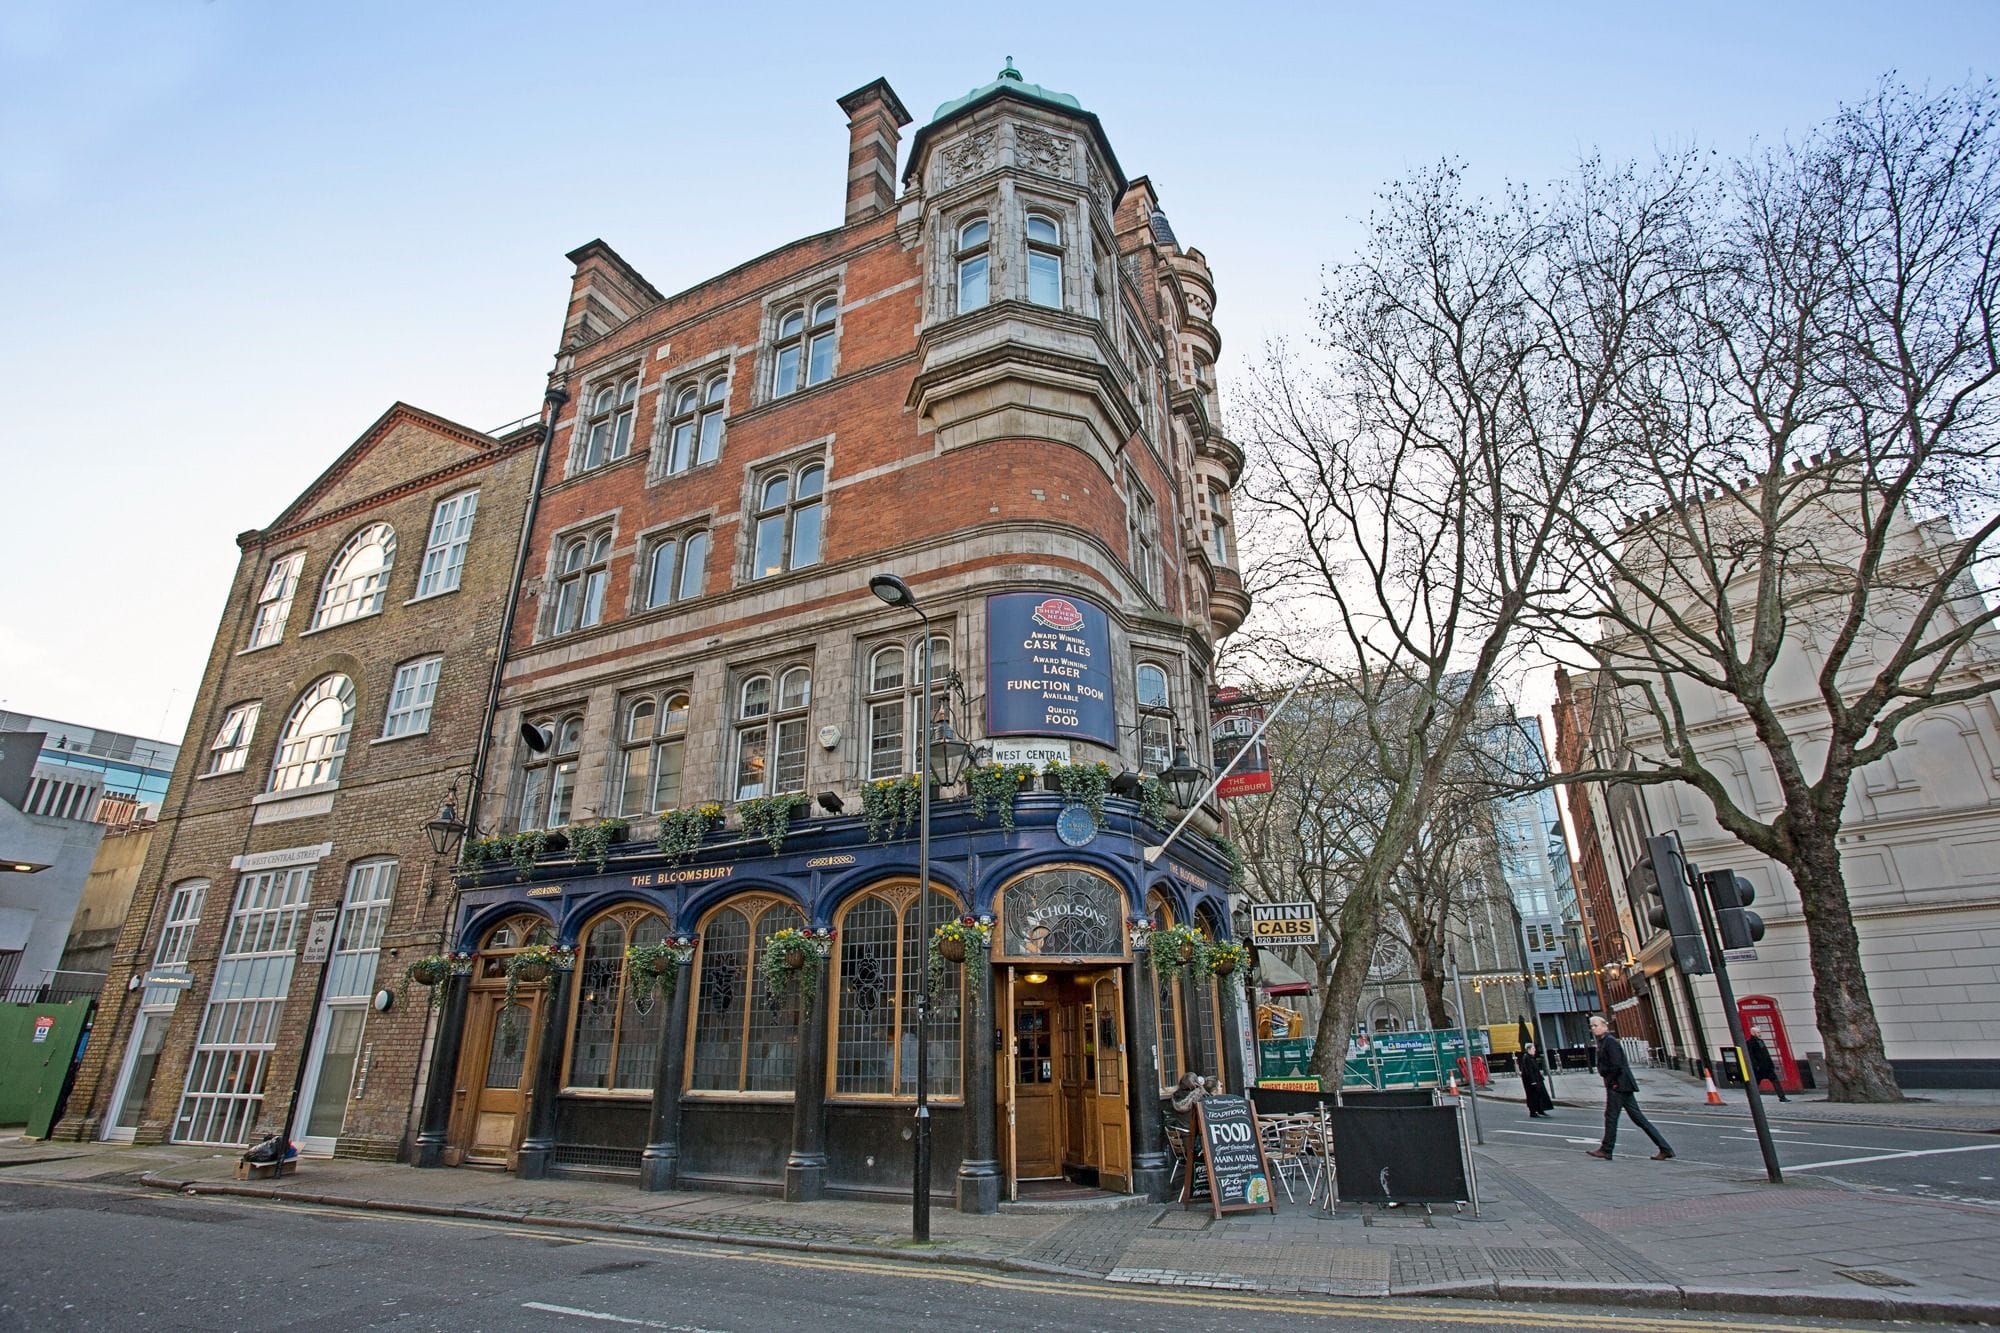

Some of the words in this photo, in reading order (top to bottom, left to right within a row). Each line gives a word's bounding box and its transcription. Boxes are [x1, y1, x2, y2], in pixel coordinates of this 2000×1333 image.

[1038, 608, 1080, 619] SHEPHERD
[1048, 614, 1073, 622] NEAME
[1032, 632, 1058, 640] AWARD
[1058, 633, 1086, 646] WINNING
[1024, 640, 1058, 650] CASK
[1065, 643, 1090, 656] ALES
[1032, 656, 1060, 664] AWARD
[1060, 658, 1088, 670] WINNING
[1043, 664, 1080, 678] LAGER
[1007, 680, 1070, 692] FUNCTION
[1077, 684, 1104, 700] ROOM
[1042, 692, 1079, 702] AVAILABLE
[1048, 706, 1076, 715] QUALITY
[1045, 714, 1079, 726] FOOD
[996, 750, 1021, 760] WEST
[1026, 750, 1068, 760] CENTRAL
[1220, 782, 1267, 794] OOMSBURY
[1228, 777, 1246, 786] THE
[268, 852, 296, 864] CENTRAL
[296, 849, 320, 860] STREET
[631, 875, 652, 886] THE
[657, 866, 734, 884] BLOOMSBURY
[1256, 906, 1310, 920] MINI
[1258, 920, 1312, 934] CABS
[1257, 936, 1272, 944] 020
[1208, 1122, 1251, 1145] FOOD
[1214, 1155, 1234, 1164] MAIN
[1234, 1154, 1258, 1162] MEALS
